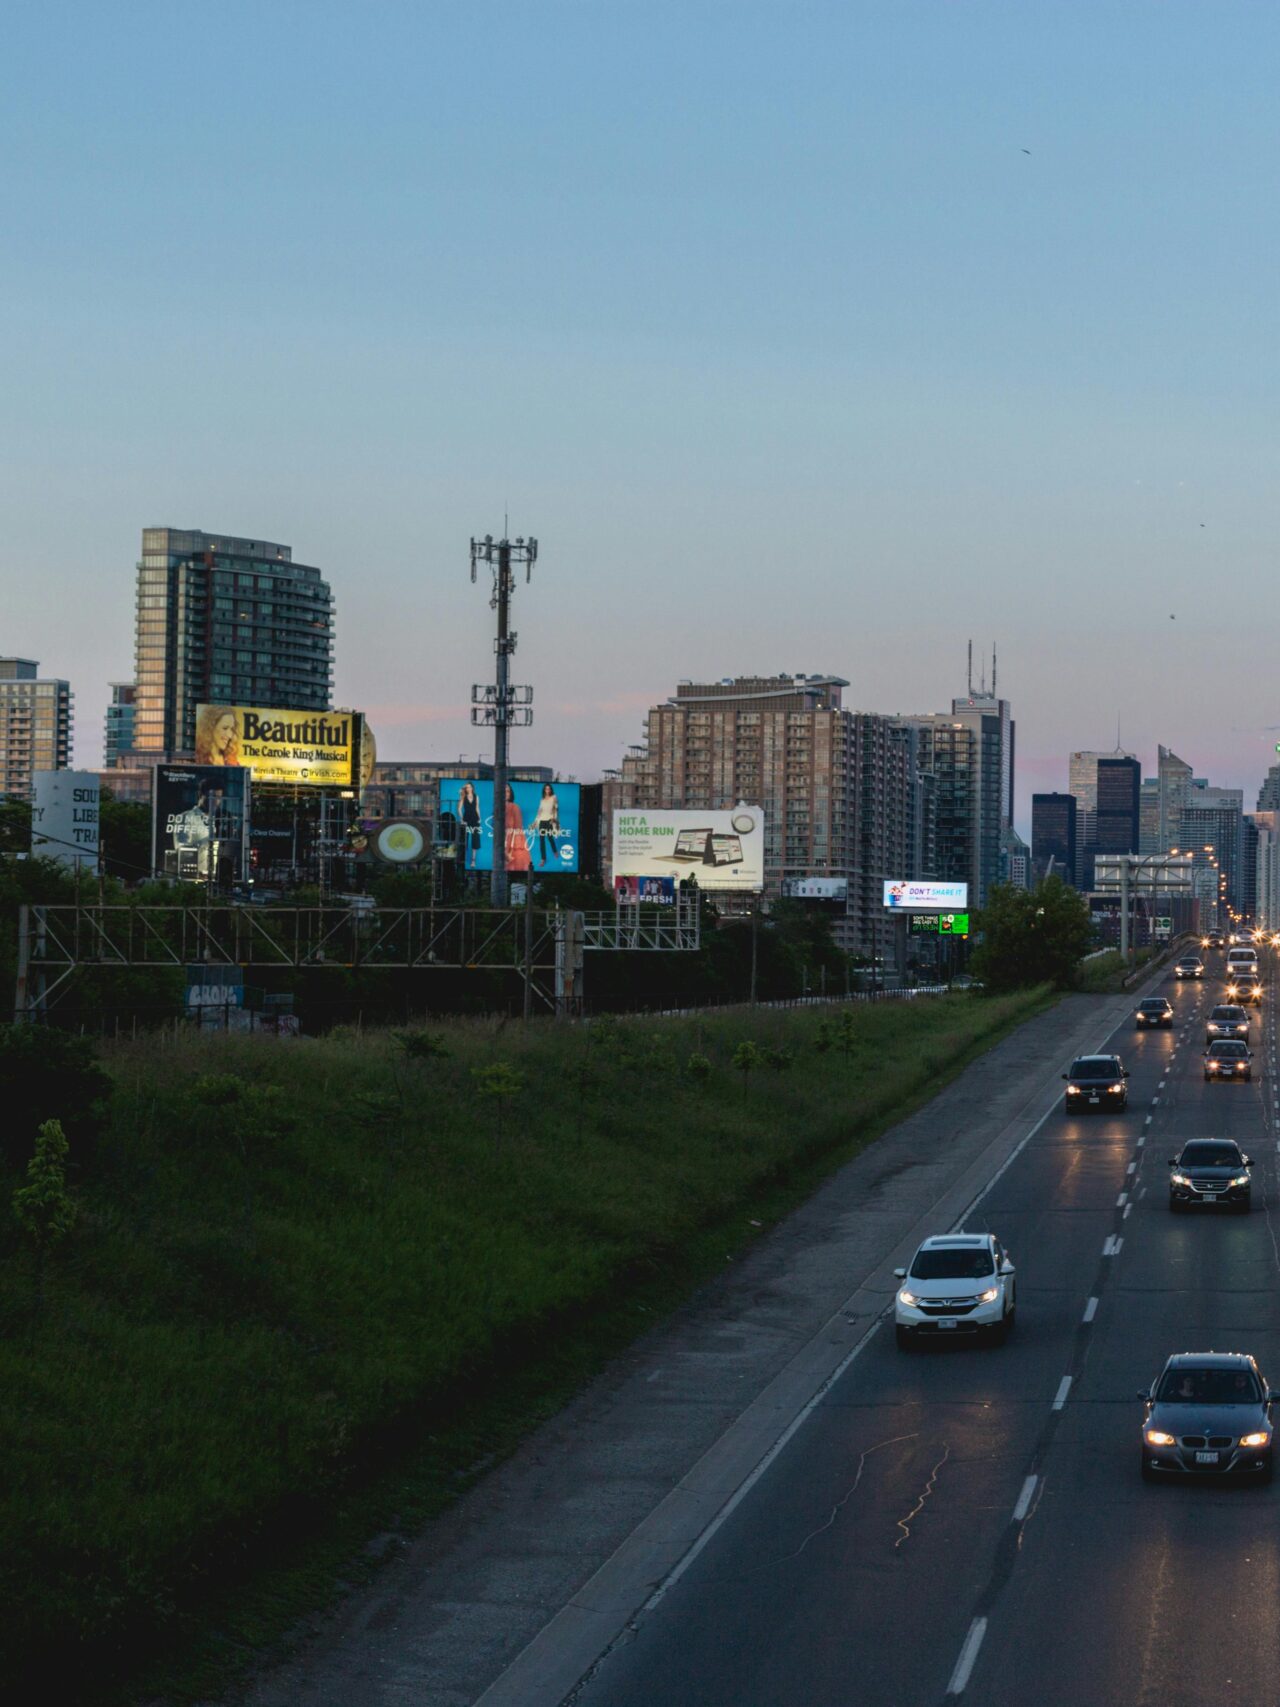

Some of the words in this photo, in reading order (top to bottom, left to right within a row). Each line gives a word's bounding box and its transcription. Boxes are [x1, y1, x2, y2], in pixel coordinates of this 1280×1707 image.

[243, 712, 348, 747] Beautiful
[242, 744, 260, 756] The
[261, 746, 290, 758] Carole
[292, 748, 313, 762] King
[315, 749, 348, 761] Musical
[619, 816, 637, 825] HIT
[640, 816, 646, 825] A
[539, 828, 571, 838] CHOICE
[619, 827, 650, 835] HOME
[652, 827, 674, 835] RUN
[932, 888, 953, 896] SHARE
[640, 895, 673, 904] FRESH
